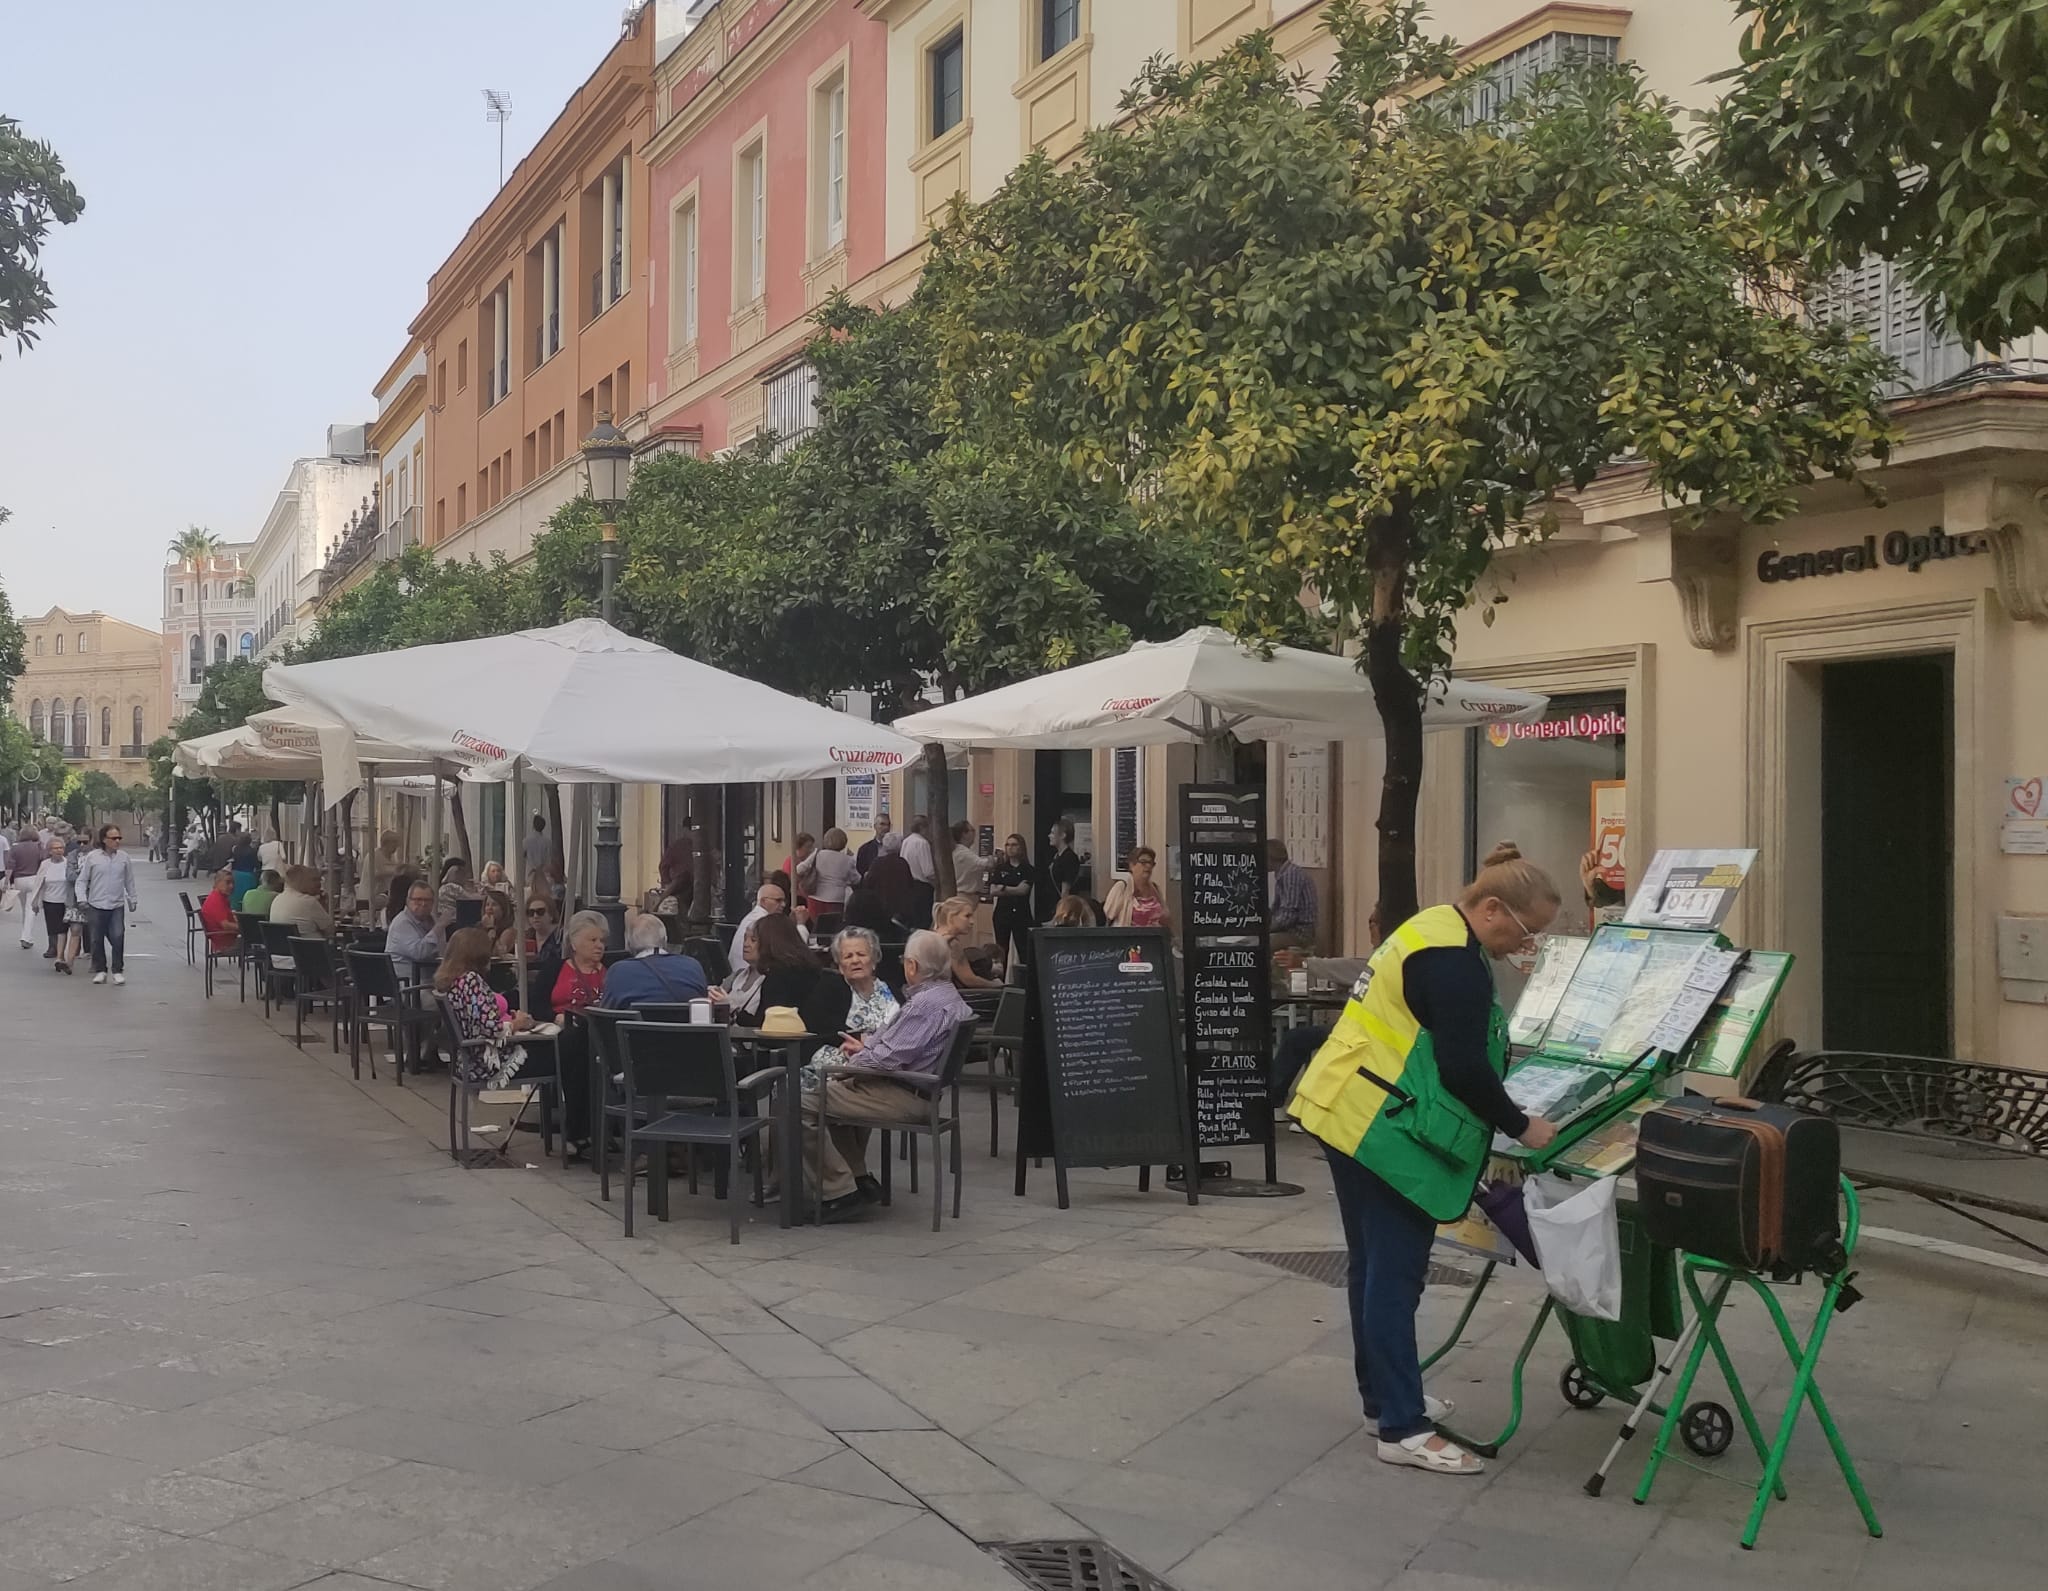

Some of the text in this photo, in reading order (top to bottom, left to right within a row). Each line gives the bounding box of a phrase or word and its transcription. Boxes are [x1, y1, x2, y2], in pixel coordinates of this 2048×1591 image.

[1757, 535, 1879, 583] General
[1513, 715, 1575, 739] General
[451, 729, 508, 762] Cruzcampo
[828, 745, 903, 767] Cruzcampo
[1190, 852, 1217, 867] MENU
[1222, 853, 1238, 867] DEL
[1203, 872, 1223, 887] Plato
[1203, 891, 1225, 905] Plato
[1194, 972, 1228, 988] Ensalada
[1194, 990, 1229, 1004] Ensalada
[1219, 1006, 1231, 1017] del
[1196, 1022, 1240, 1038] Salmorejo
[1221, 1055, 1257, 1069] PLATOS
[1197, 1087, 1214, 1098] Pollo
